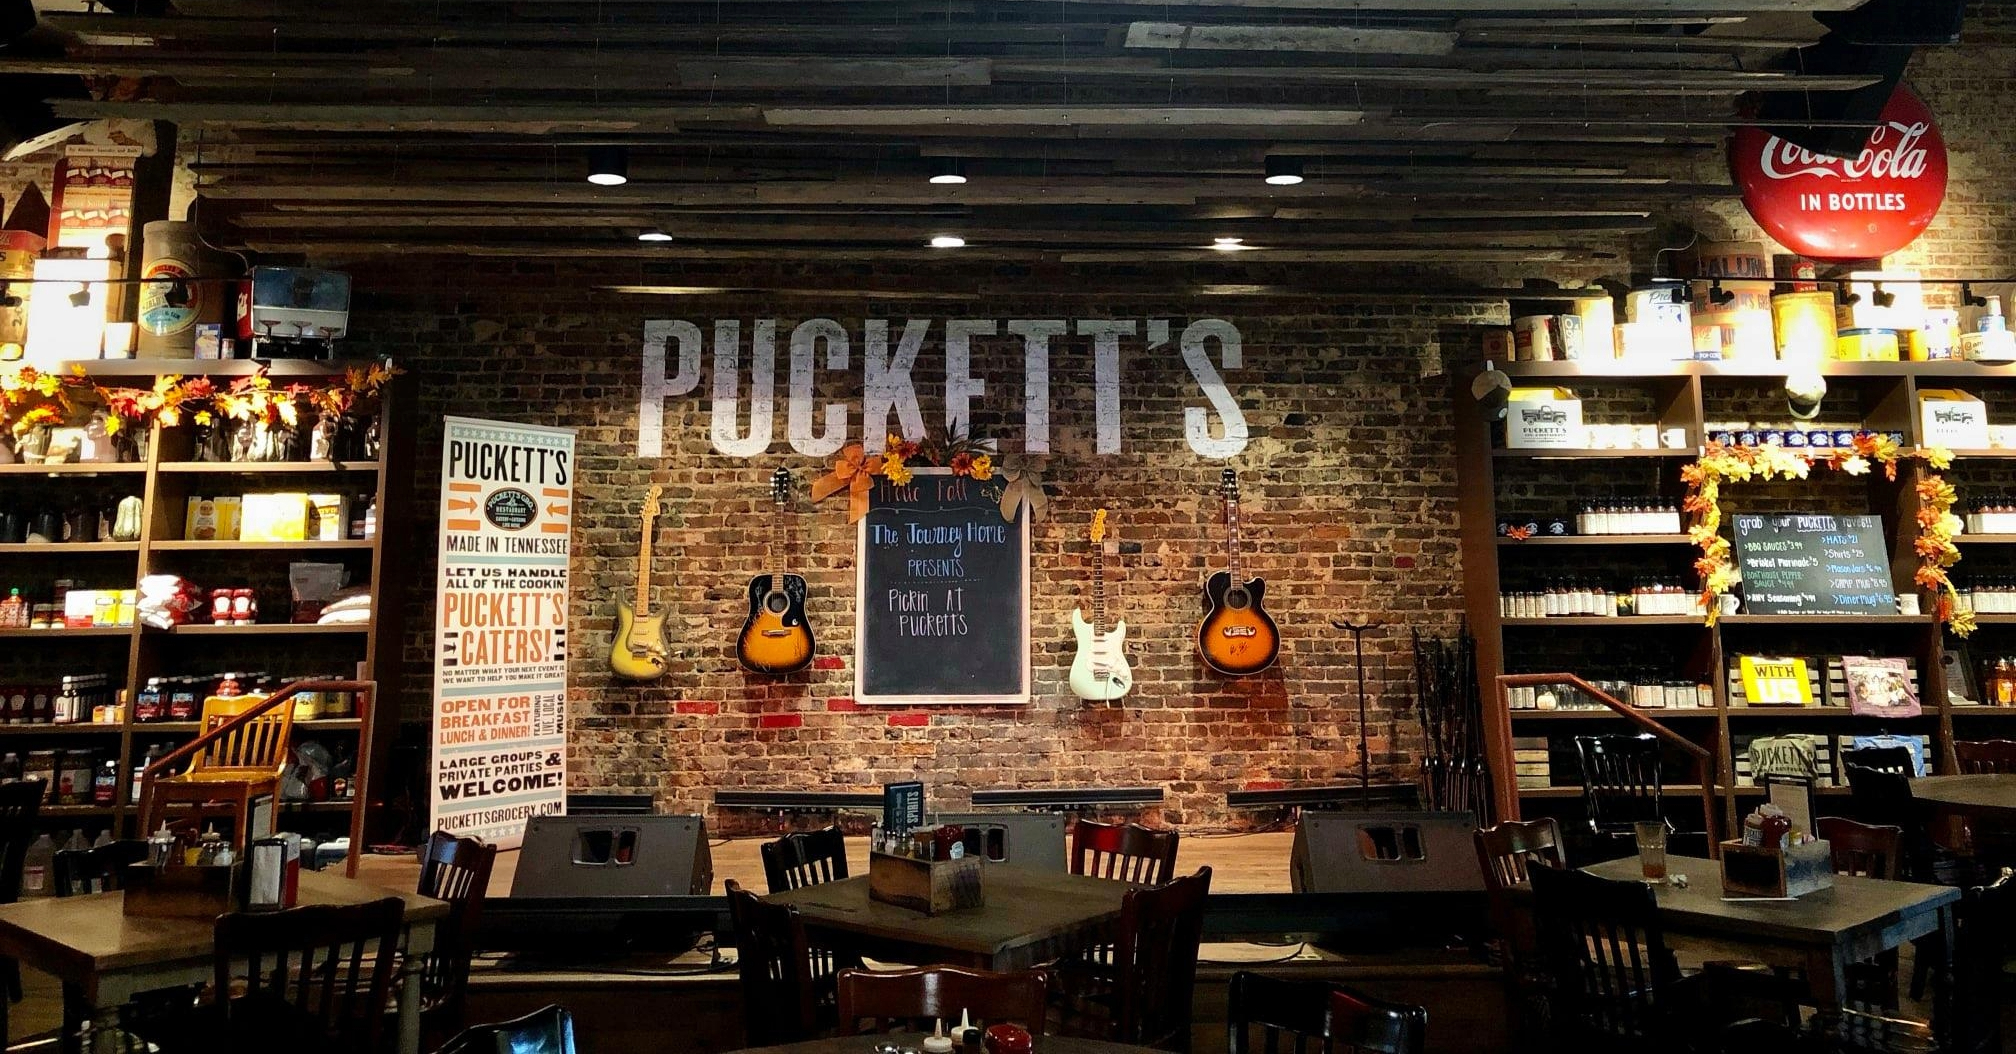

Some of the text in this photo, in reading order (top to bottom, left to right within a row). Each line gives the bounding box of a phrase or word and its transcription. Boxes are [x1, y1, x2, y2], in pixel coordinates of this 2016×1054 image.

[1801, 193, 1905, 211] IN BOTTLES
[638, 319, 1248, 459] PUCKETT'S
[449, 440, 567, 486] PUCKETT'S
[488, 491, 521, 508] PUCKETT'S
[938, 479, 968, 503] Fall
[1740, 516, 1763, 536] grab
[1772, 517, 1791, 533] your
[446, 535, 568, 554] MADE IN TENNESSEE
[869, 522, 1006, 558] The Journey Home
[1826, 535, 1847, 544] HATS
[1828, 548, 1851, 559] Shirts
[445, 568, 566, 578] LET US HANDLE
[908, 559, 964, 577] PRESENTS
[446, 578, 567, 589] ALL OF THE COOKIN'
[946, 586, 965, 612] AT
[443, 592, 564, 628] PUCKETT'S
[461, 629, 551, 666] CATERS!
[1754, 665, 1796, 678] WITH
[1755, 680, 1803, 703] US
[441, 696, 531, 713] OPEN FOR
[542, 694, 555, 735] LIVE LOCAL
[440, 711, 531, 729] BREAKFAST
[440, 725, 531, 744] LUNCH & DINNER!
[440, 751, 543, 769] LARGE GROUPS
[1752, 745, 1815, 767] PUCKETTS
[439, 752, 562, 782] PRIVATE PARTIES &
[439, 772, 563, 801] WELCOME!
[437, 801, 562, 831] PUCKETTSGROCERY.COM
[907, 791, 919, 824] SPIRITS
